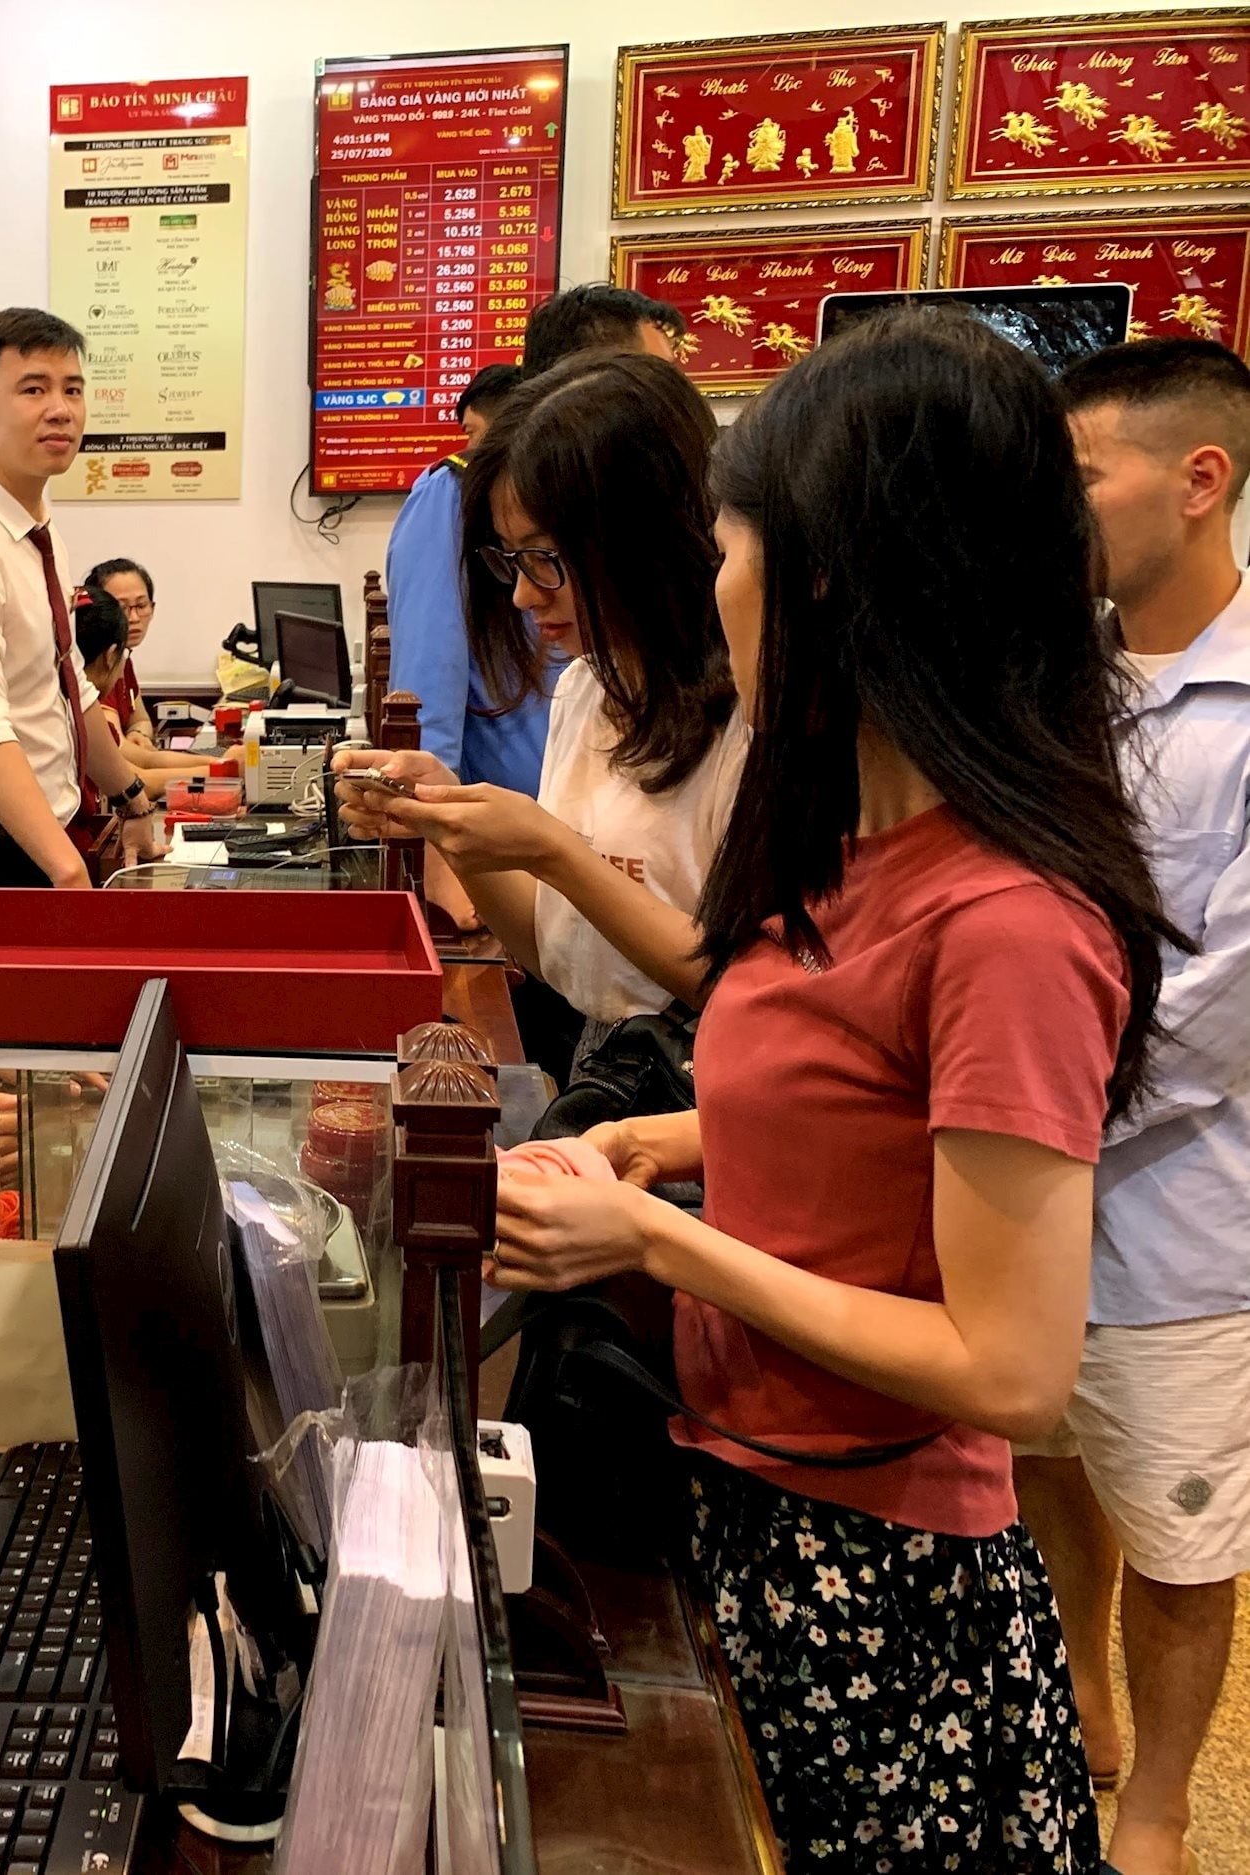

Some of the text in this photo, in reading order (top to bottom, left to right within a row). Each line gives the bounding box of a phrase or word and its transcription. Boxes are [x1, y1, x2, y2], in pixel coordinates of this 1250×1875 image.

[770, 73, 802, 92] Lộc
[827, 69, 857, 89] Thọ
[90, 89, 236, 108] BẢO TÍN MINH CHÂU
[360, 84, 527, 108] BẢNG GIÁ VÀNG MỚI NHẤT
[354, 112, 379, 124] VÀNG
[382, 113, 406, 122] TRAO
[461, 108, 480, 119] 24K
[488, 108, 508, 117] Fine
[510, 106, 531, 115] Gold
[502, 125, 533, 137] 1.901
[333, 133, 390, 145] 4:01:16 PM
[331, 148, 392, 160] 25/07/2020
[436, 168, 477, 179] MUA VÀO
[493, 166, 527, 176] BÁN RA
[445, 188, 476, 200] 2.628
[500, 186, 531, 198] 2.678
[444, 208, 476, 220] 5.256
[499, 206, 531, 218] 5.356
[444, 225, 482, 238] 10.512
[499, 222, 537, 235] 10.712
[327, 240, 355, 250] LONG
[490, 243, 528, 255] 16.068
[406, 248, 412, 256] 3
[437, 245, 475, 258] 15.768
[1094, 242, 1154, 261] Thành
[1171, 240, 1216, 263] Công
[436, 264, 475, 275] 26.280
[489, 262, 528, 274] 26.780
[759, 260, 814, 279] Thành
[832, 257, 874, 279] Công
[436, 281, 474, 294] 52.560
[489, 279, 527, 291] 53.560
[435, 300, 473, 312] 52.560
[488, 298, 526, 310] 53.560
[441, 320, 472, 330] 5.200
[495, 318, 526, 329] 5.330
[440, 338, 472, 349] 5.210
[495, 335, 525, 347] 5.340
[440, 357, 471, 368] 5.210
[439, 374, 470, 385] 5.200
[323, 393, 377, 405] VÀNG SJC
